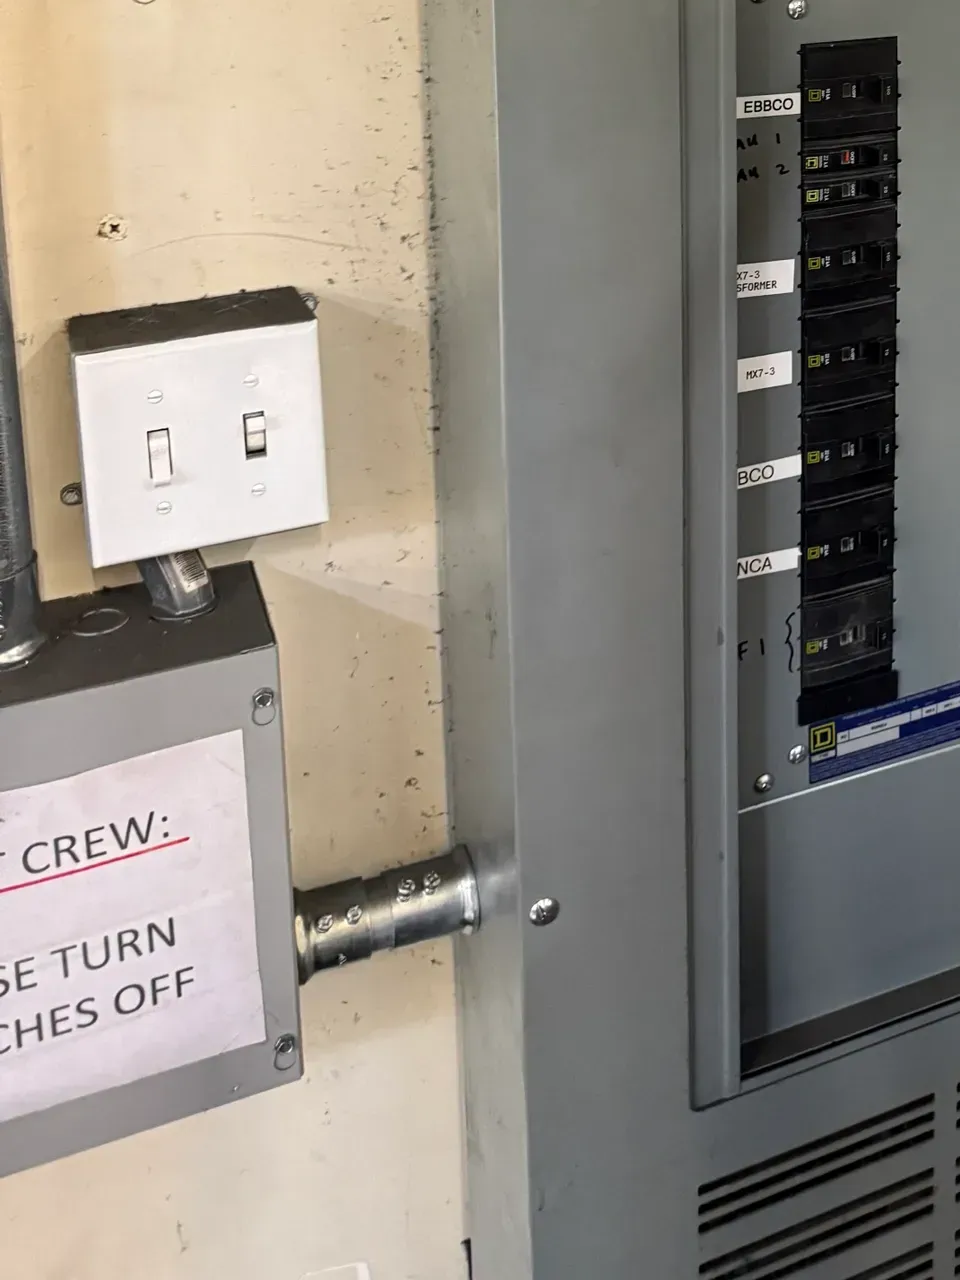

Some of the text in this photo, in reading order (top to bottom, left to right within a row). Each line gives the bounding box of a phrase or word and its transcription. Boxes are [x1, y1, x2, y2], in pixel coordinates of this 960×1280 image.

[744, 98, 794, 114] EBBCO
[775, 164, 790, 175] 2
[736, 280, 777, 293] SFORMER
[746, 366, 776, 380] MX7-3
[737, 464, 775, 486] BCO
[737, 557, 773, 576] NCA
[22, 811, 169, 874] CREW:
[50, 917, 176, 979] TURN
[114, 966, 195, 1015] OFF
